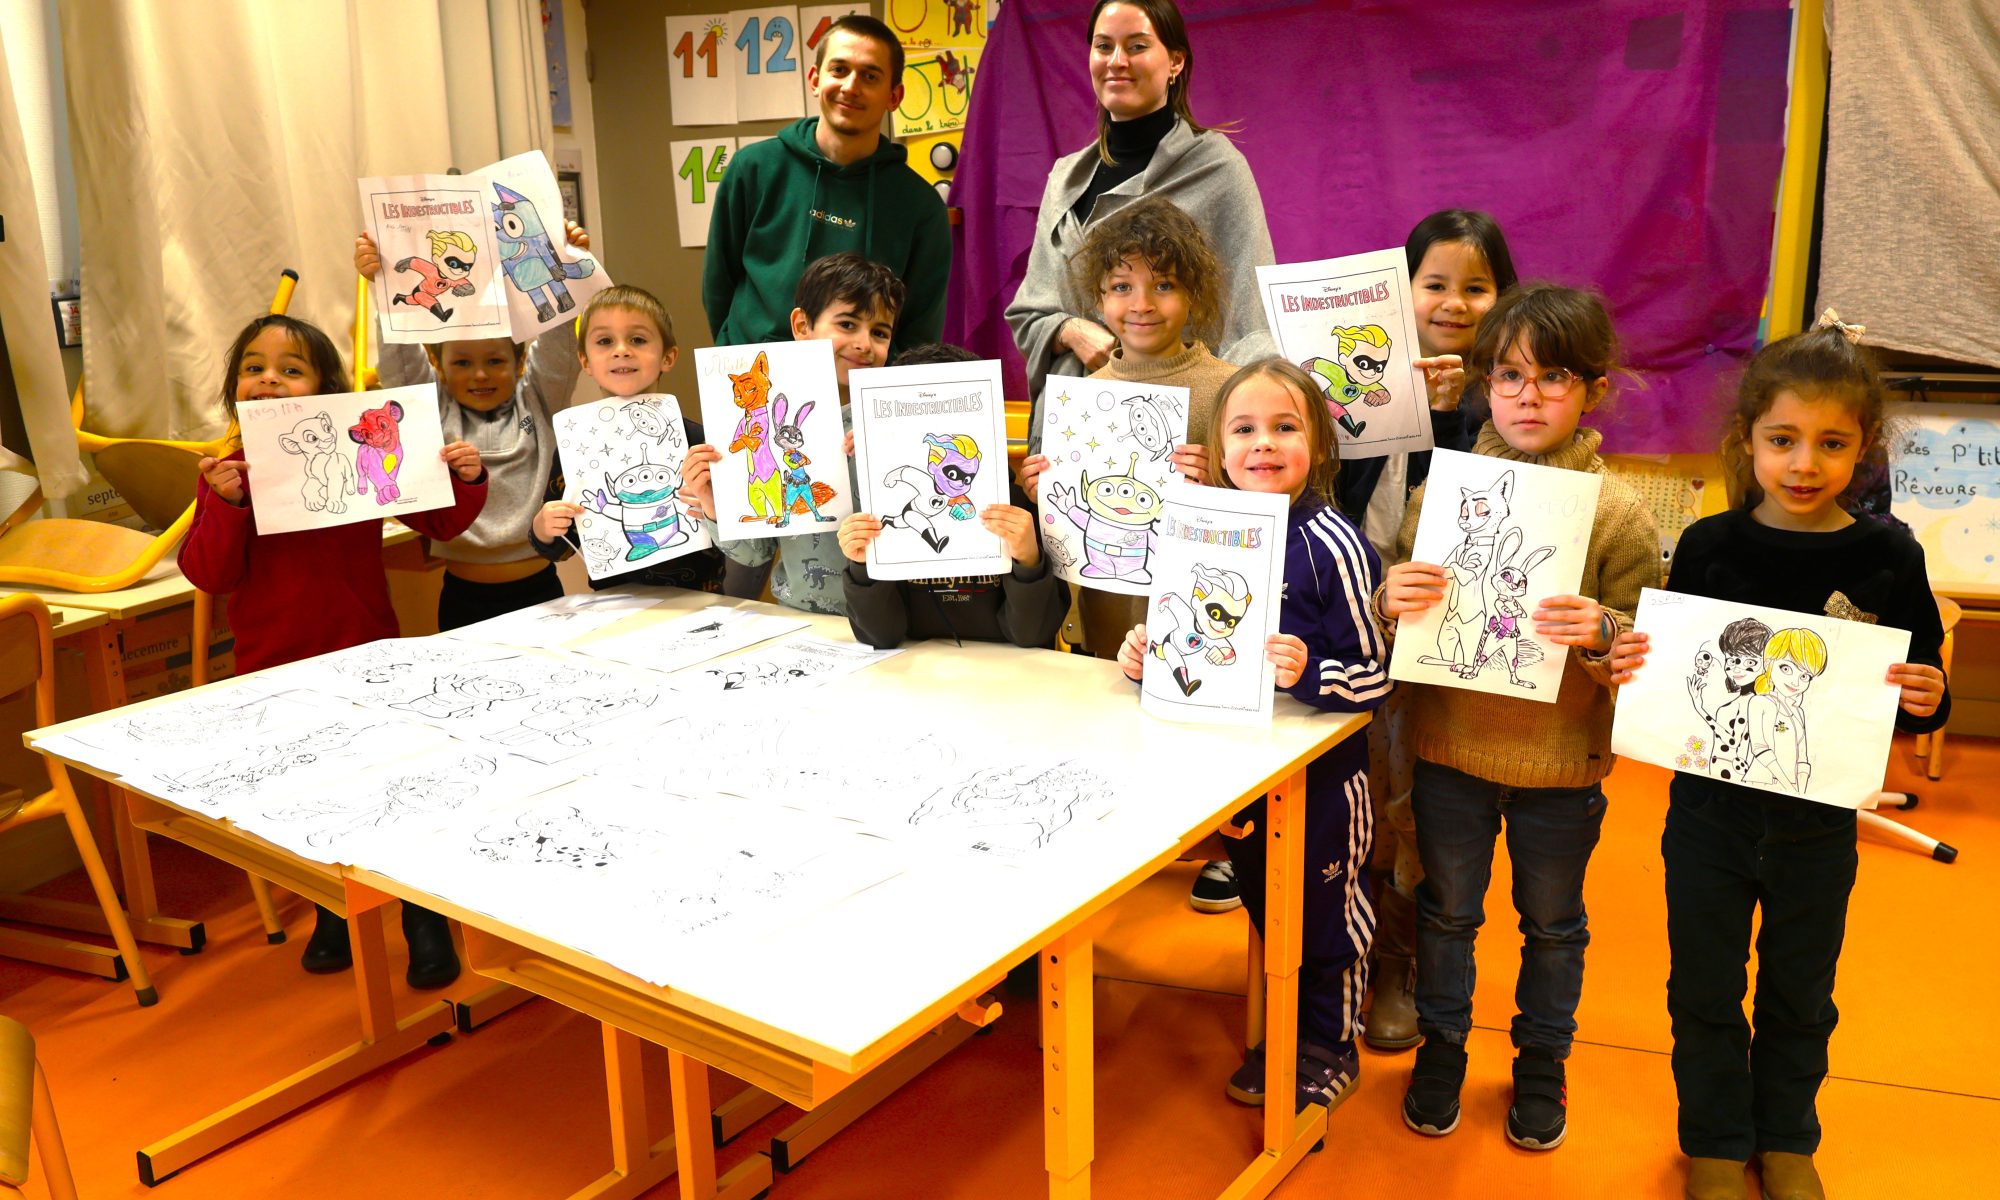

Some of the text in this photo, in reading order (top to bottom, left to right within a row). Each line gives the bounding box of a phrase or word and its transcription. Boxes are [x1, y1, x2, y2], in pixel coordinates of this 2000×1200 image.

[673, 31, 718, 78] 11
[735, 17, 796, 74] 12
[678, 145, 727, 204] 14
[382, 200, 475, 219] LES INDESTRUCTIBLES
[1280, 280, 1390, 313] LES INDESTRUCTIBLES
[873, 391, 983, 419] LES INDESTRUCTIBLES
[1904, 441, 1930, 456] Les
[1176, 520, 1262, 549] INDESTRUCTIBLES
